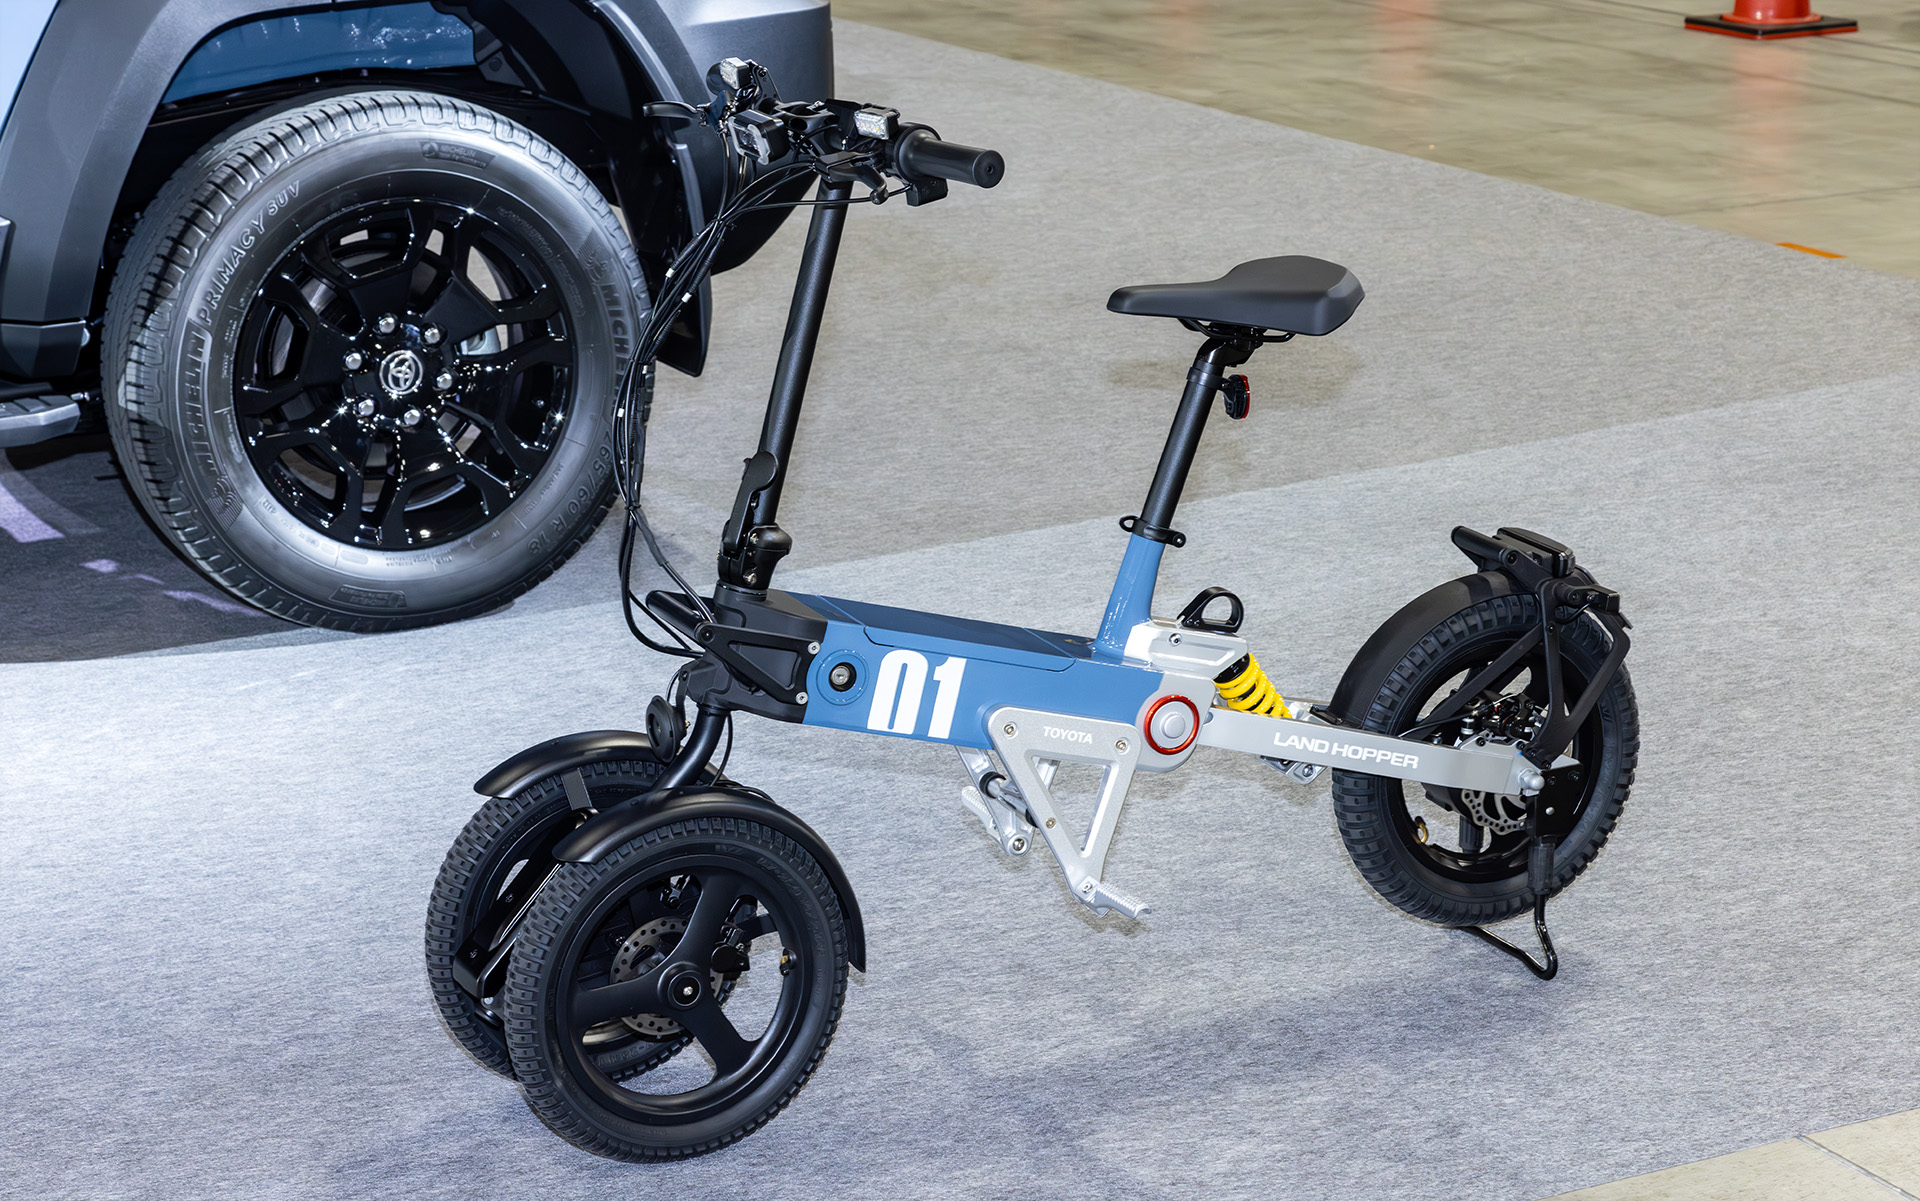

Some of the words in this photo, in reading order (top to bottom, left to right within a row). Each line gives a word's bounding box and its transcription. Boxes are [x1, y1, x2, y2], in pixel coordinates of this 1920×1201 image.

[199, 210, 265, 326] PRIMACY
[266, 180, 300, 216] SUV
[185, 331, 220, 475] MICHELIN
[866, 649, 967, 739] 01
[1043, 725, 1093, 744] TOYOTA
[1273, 731, 1330, 754] LAND
[1331, 742, 1420, 769] HOPPER
